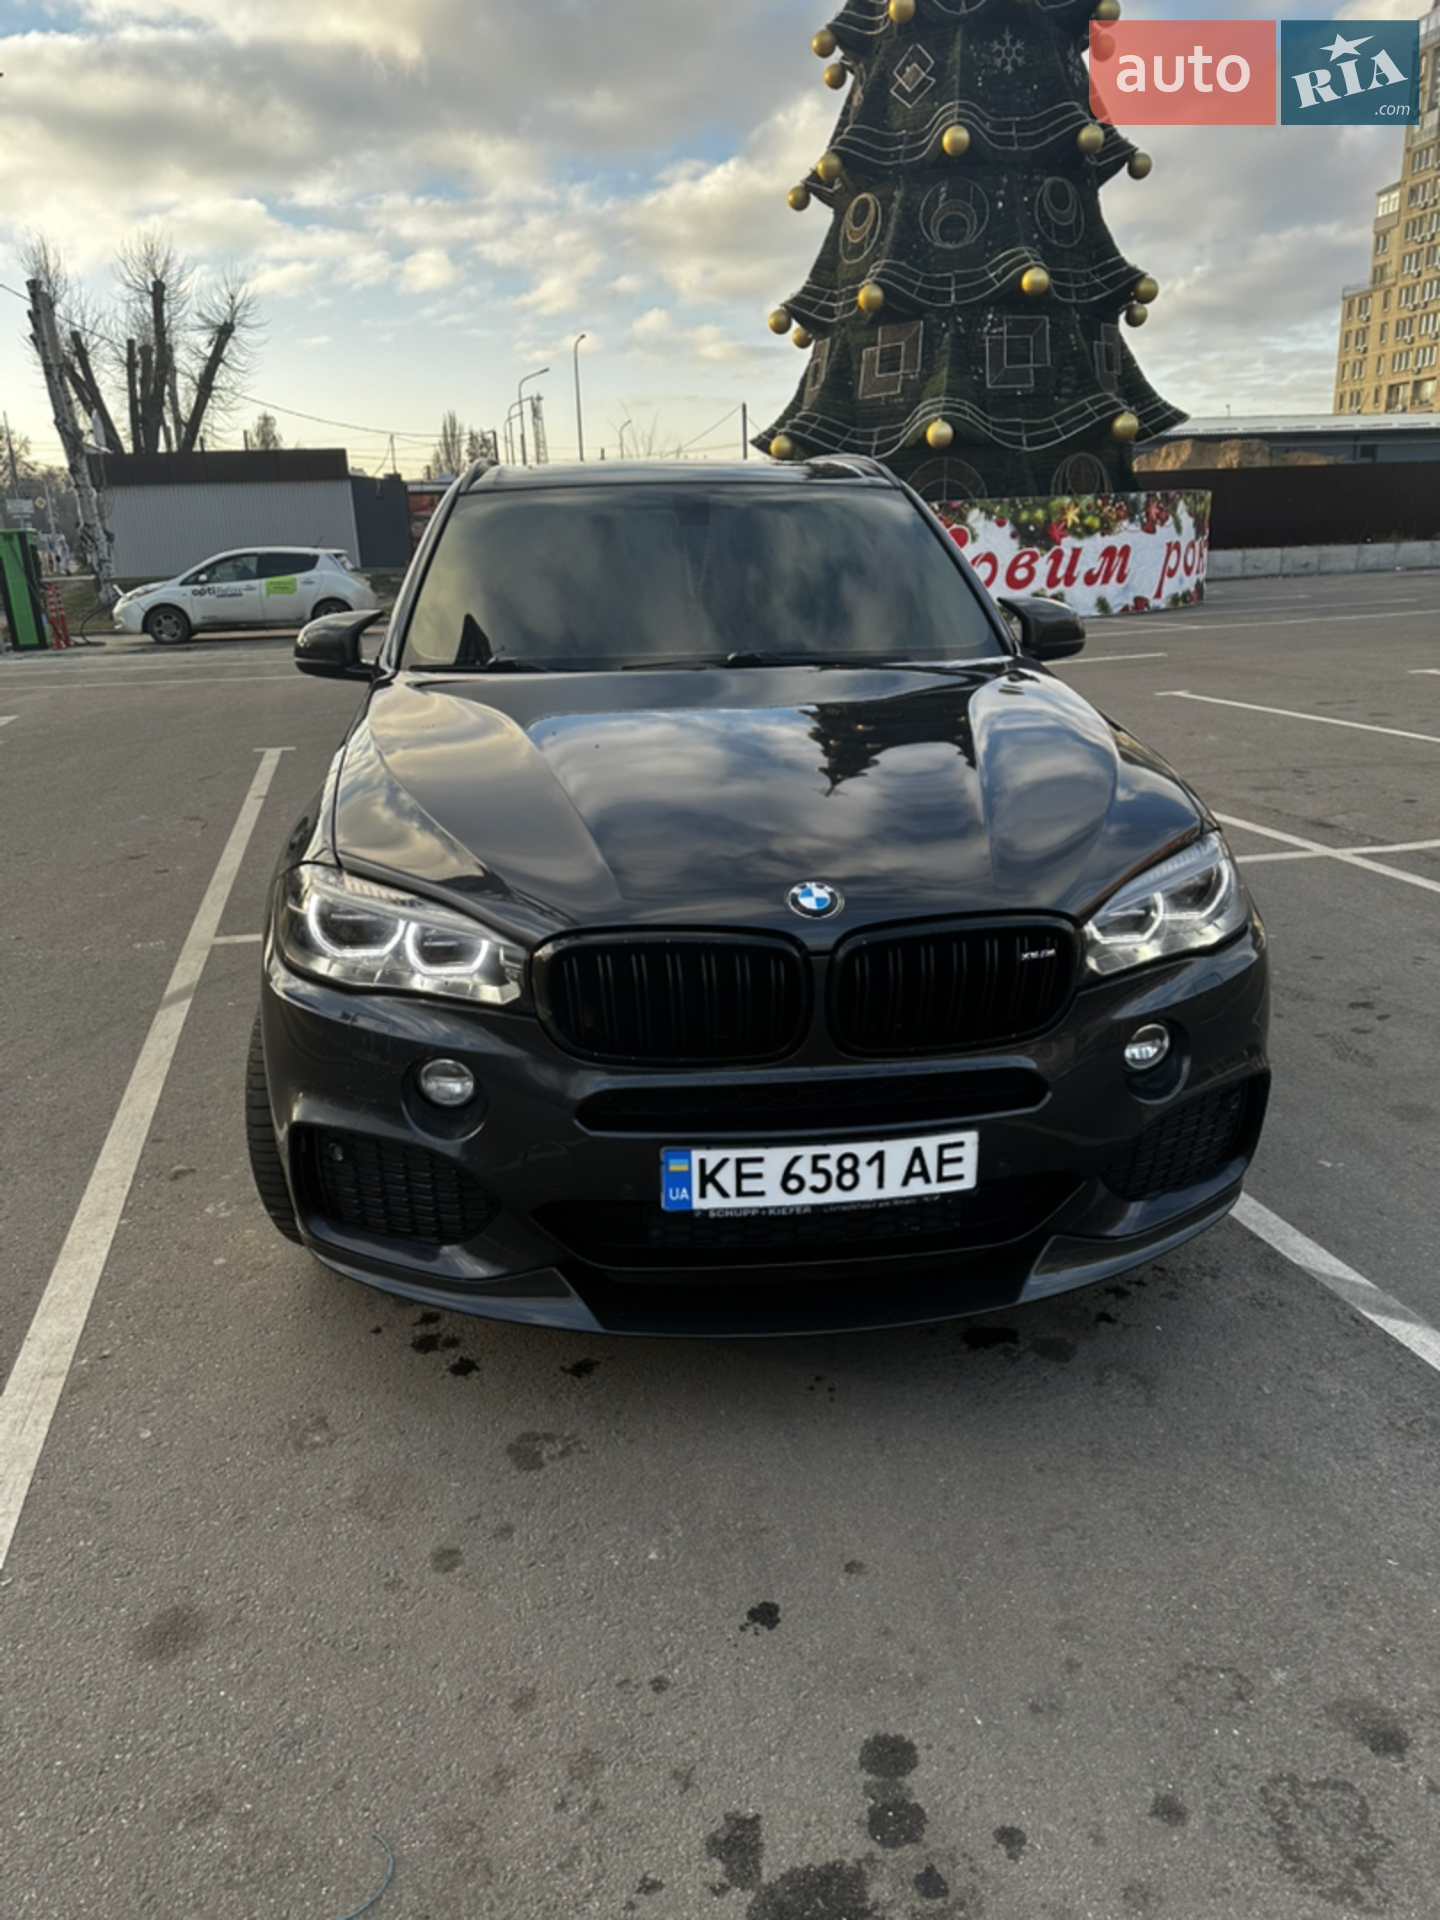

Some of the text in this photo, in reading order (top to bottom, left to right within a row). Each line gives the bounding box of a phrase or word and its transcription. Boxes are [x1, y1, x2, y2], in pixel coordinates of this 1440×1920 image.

[949, 526, 1132, 590] овим
[669, 1187, 690, 1200] UA
[698, 1141, 966, 1199] KE 6581 AE
